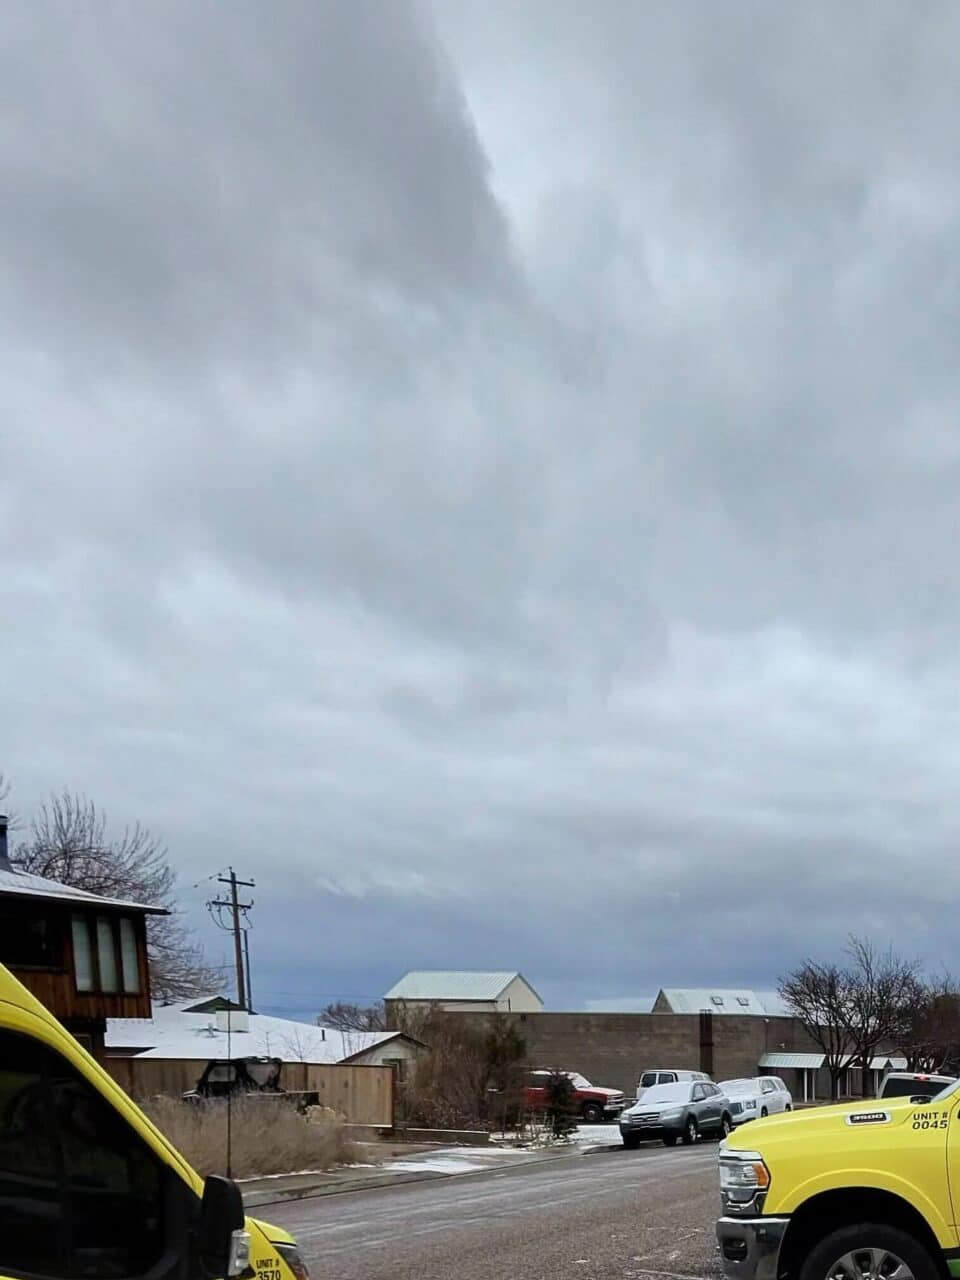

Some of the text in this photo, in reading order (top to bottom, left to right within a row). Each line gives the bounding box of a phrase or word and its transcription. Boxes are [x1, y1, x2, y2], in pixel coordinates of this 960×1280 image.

[913, 1111, 948, 1121] UNIT #
[912, 1120, 948, 1130] 0045
[256, 1259, 273, 1268] UNIT
